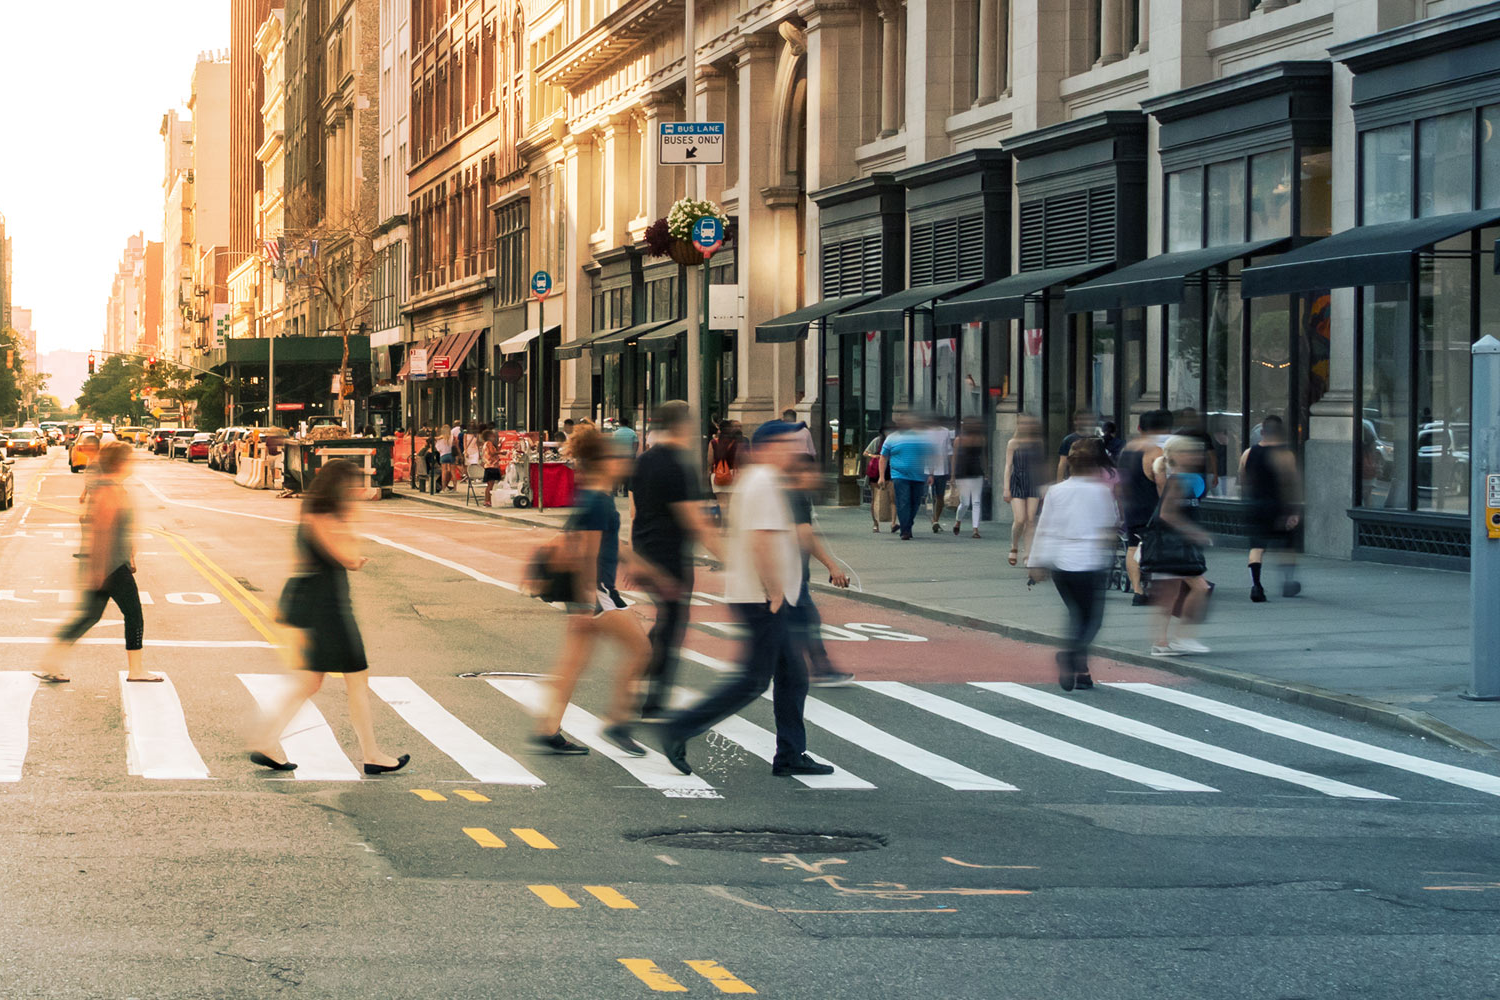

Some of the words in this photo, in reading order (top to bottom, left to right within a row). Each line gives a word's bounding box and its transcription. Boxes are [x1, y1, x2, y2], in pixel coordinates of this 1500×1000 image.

[677, 125, 694, 133] BUS
[664, 136, 694, 145] BUSES
[698, 136, 721, 145] ONLY
